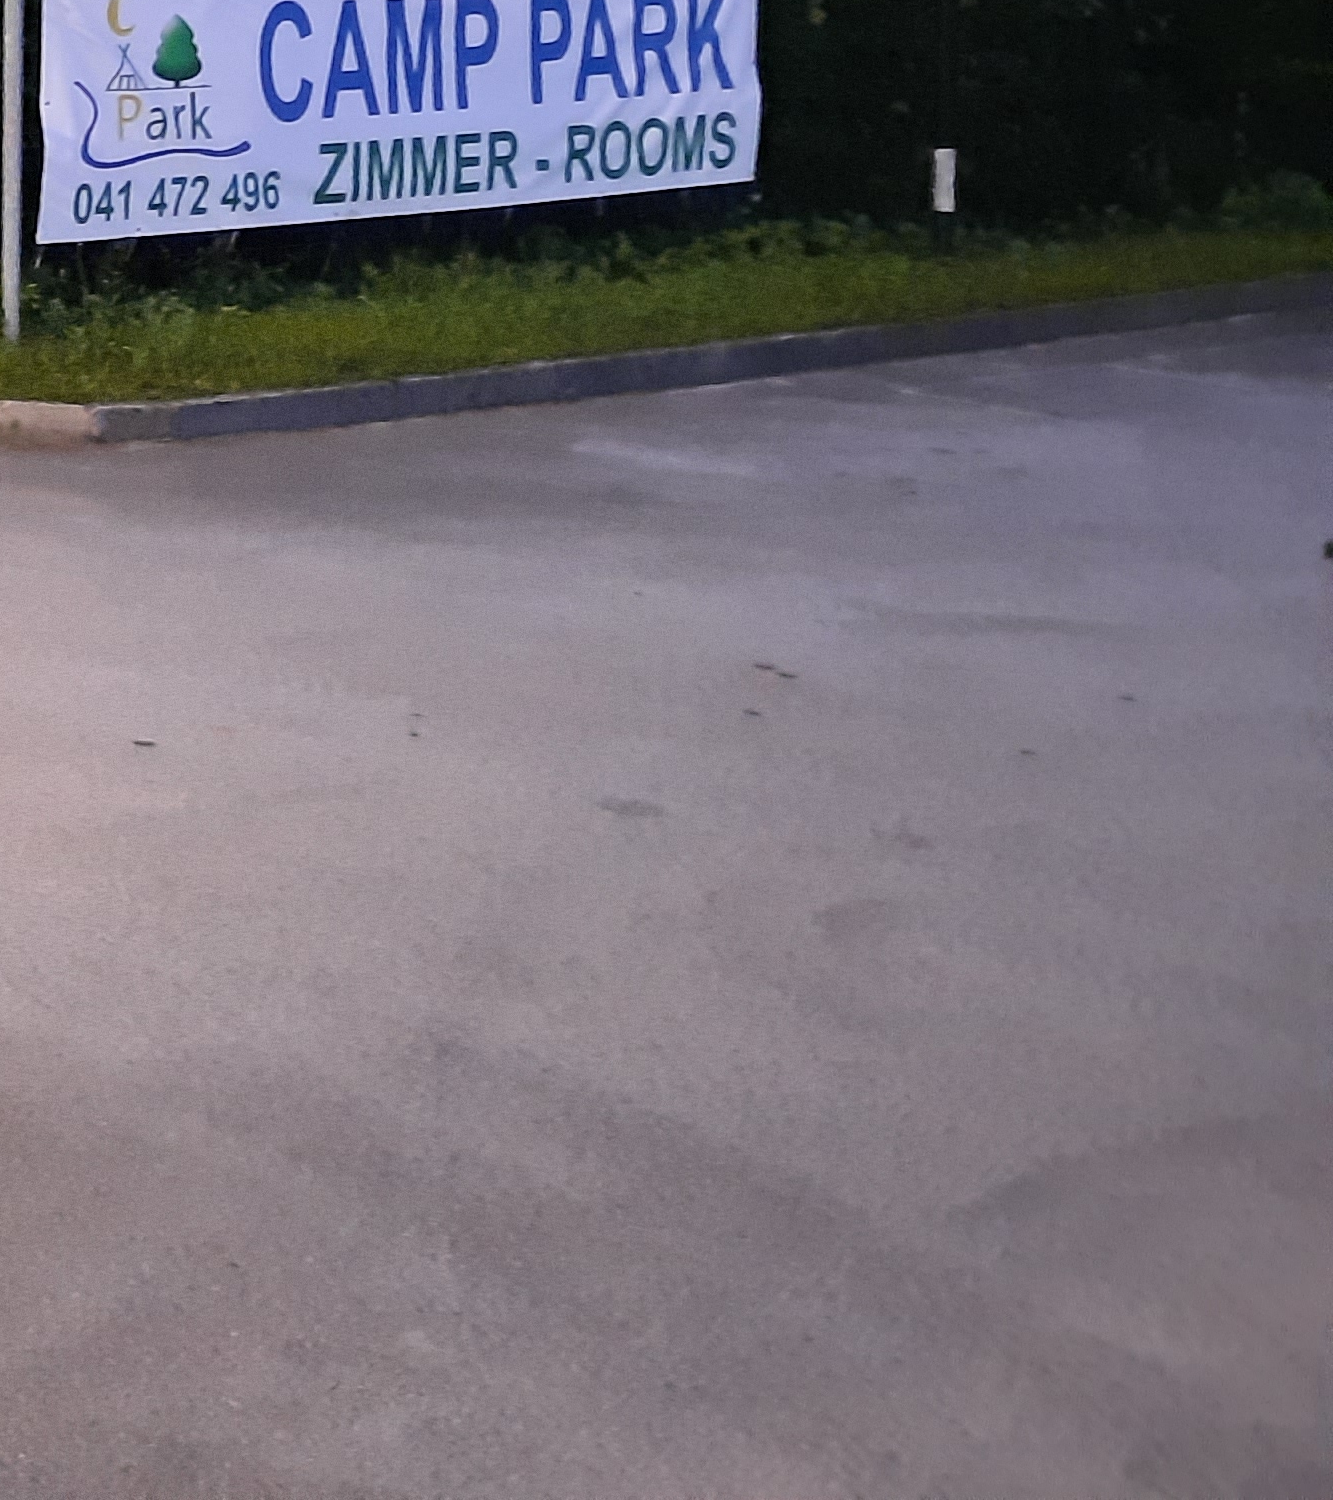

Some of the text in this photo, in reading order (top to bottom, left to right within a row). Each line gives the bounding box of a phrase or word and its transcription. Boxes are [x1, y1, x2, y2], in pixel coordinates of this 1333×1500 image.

[118, 93, 215, 143] Park
[314, 132, 519, 206] ZIMMER
[565, 112, 738, 184] ROOMS
[73, 171, 282, 225] 041 472 496
